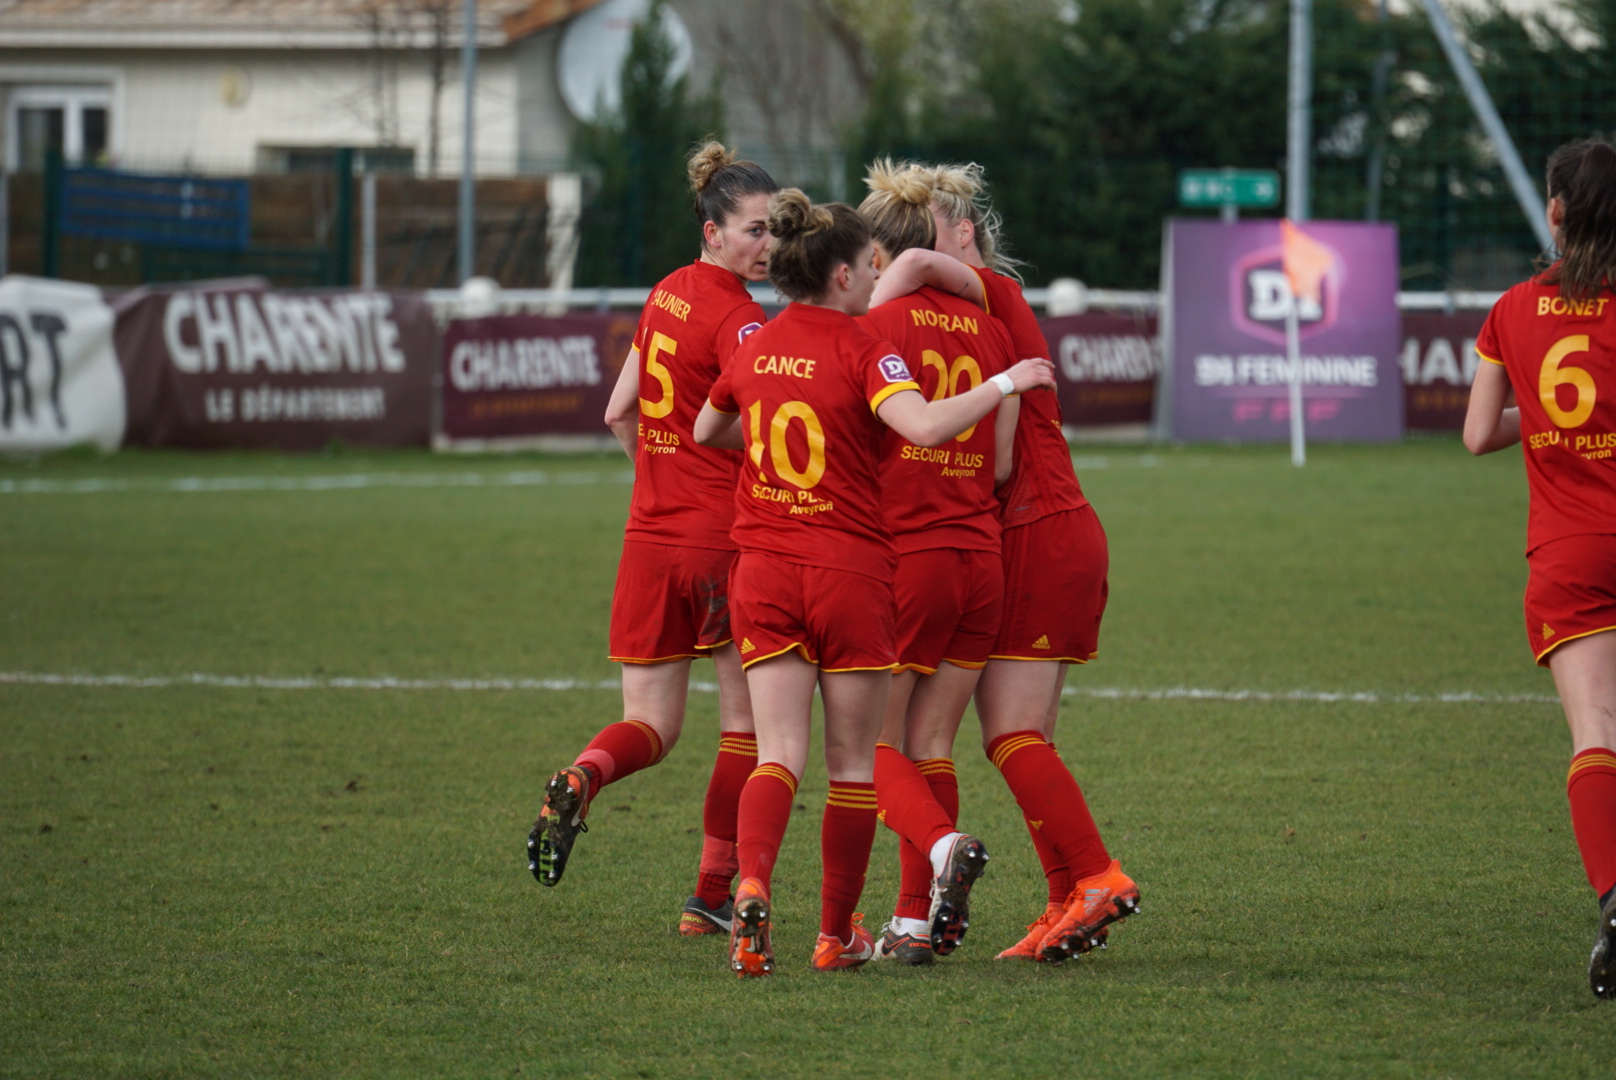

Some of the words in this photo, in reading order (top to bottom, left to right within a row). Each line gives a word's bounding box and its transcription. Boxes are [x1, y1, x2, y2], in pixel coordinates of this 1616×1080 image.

[651, 289, 691, 322] AUNIER
[1537, 296, 1609, 316] BONET
[164, 291, 405, 374] CHARENTE
[910, 309, 979, 335] NORAN
[449, 335, 601, 392] CHARENTE
[753, 355, 816, 379] CANCE
[1538, 334, 1597, 429] 6
[647, 429, 680, 446] PLUS
[748, 399, 826, 489] 10
[1575, 433, 1616, 450] PLUS
[901, 446, 950, 464] SECURI
[954, 452, 984, 468] PLUS
[941, 466, 975, 479] Aveyron
[789, 501, 833, 516] Aveyron
